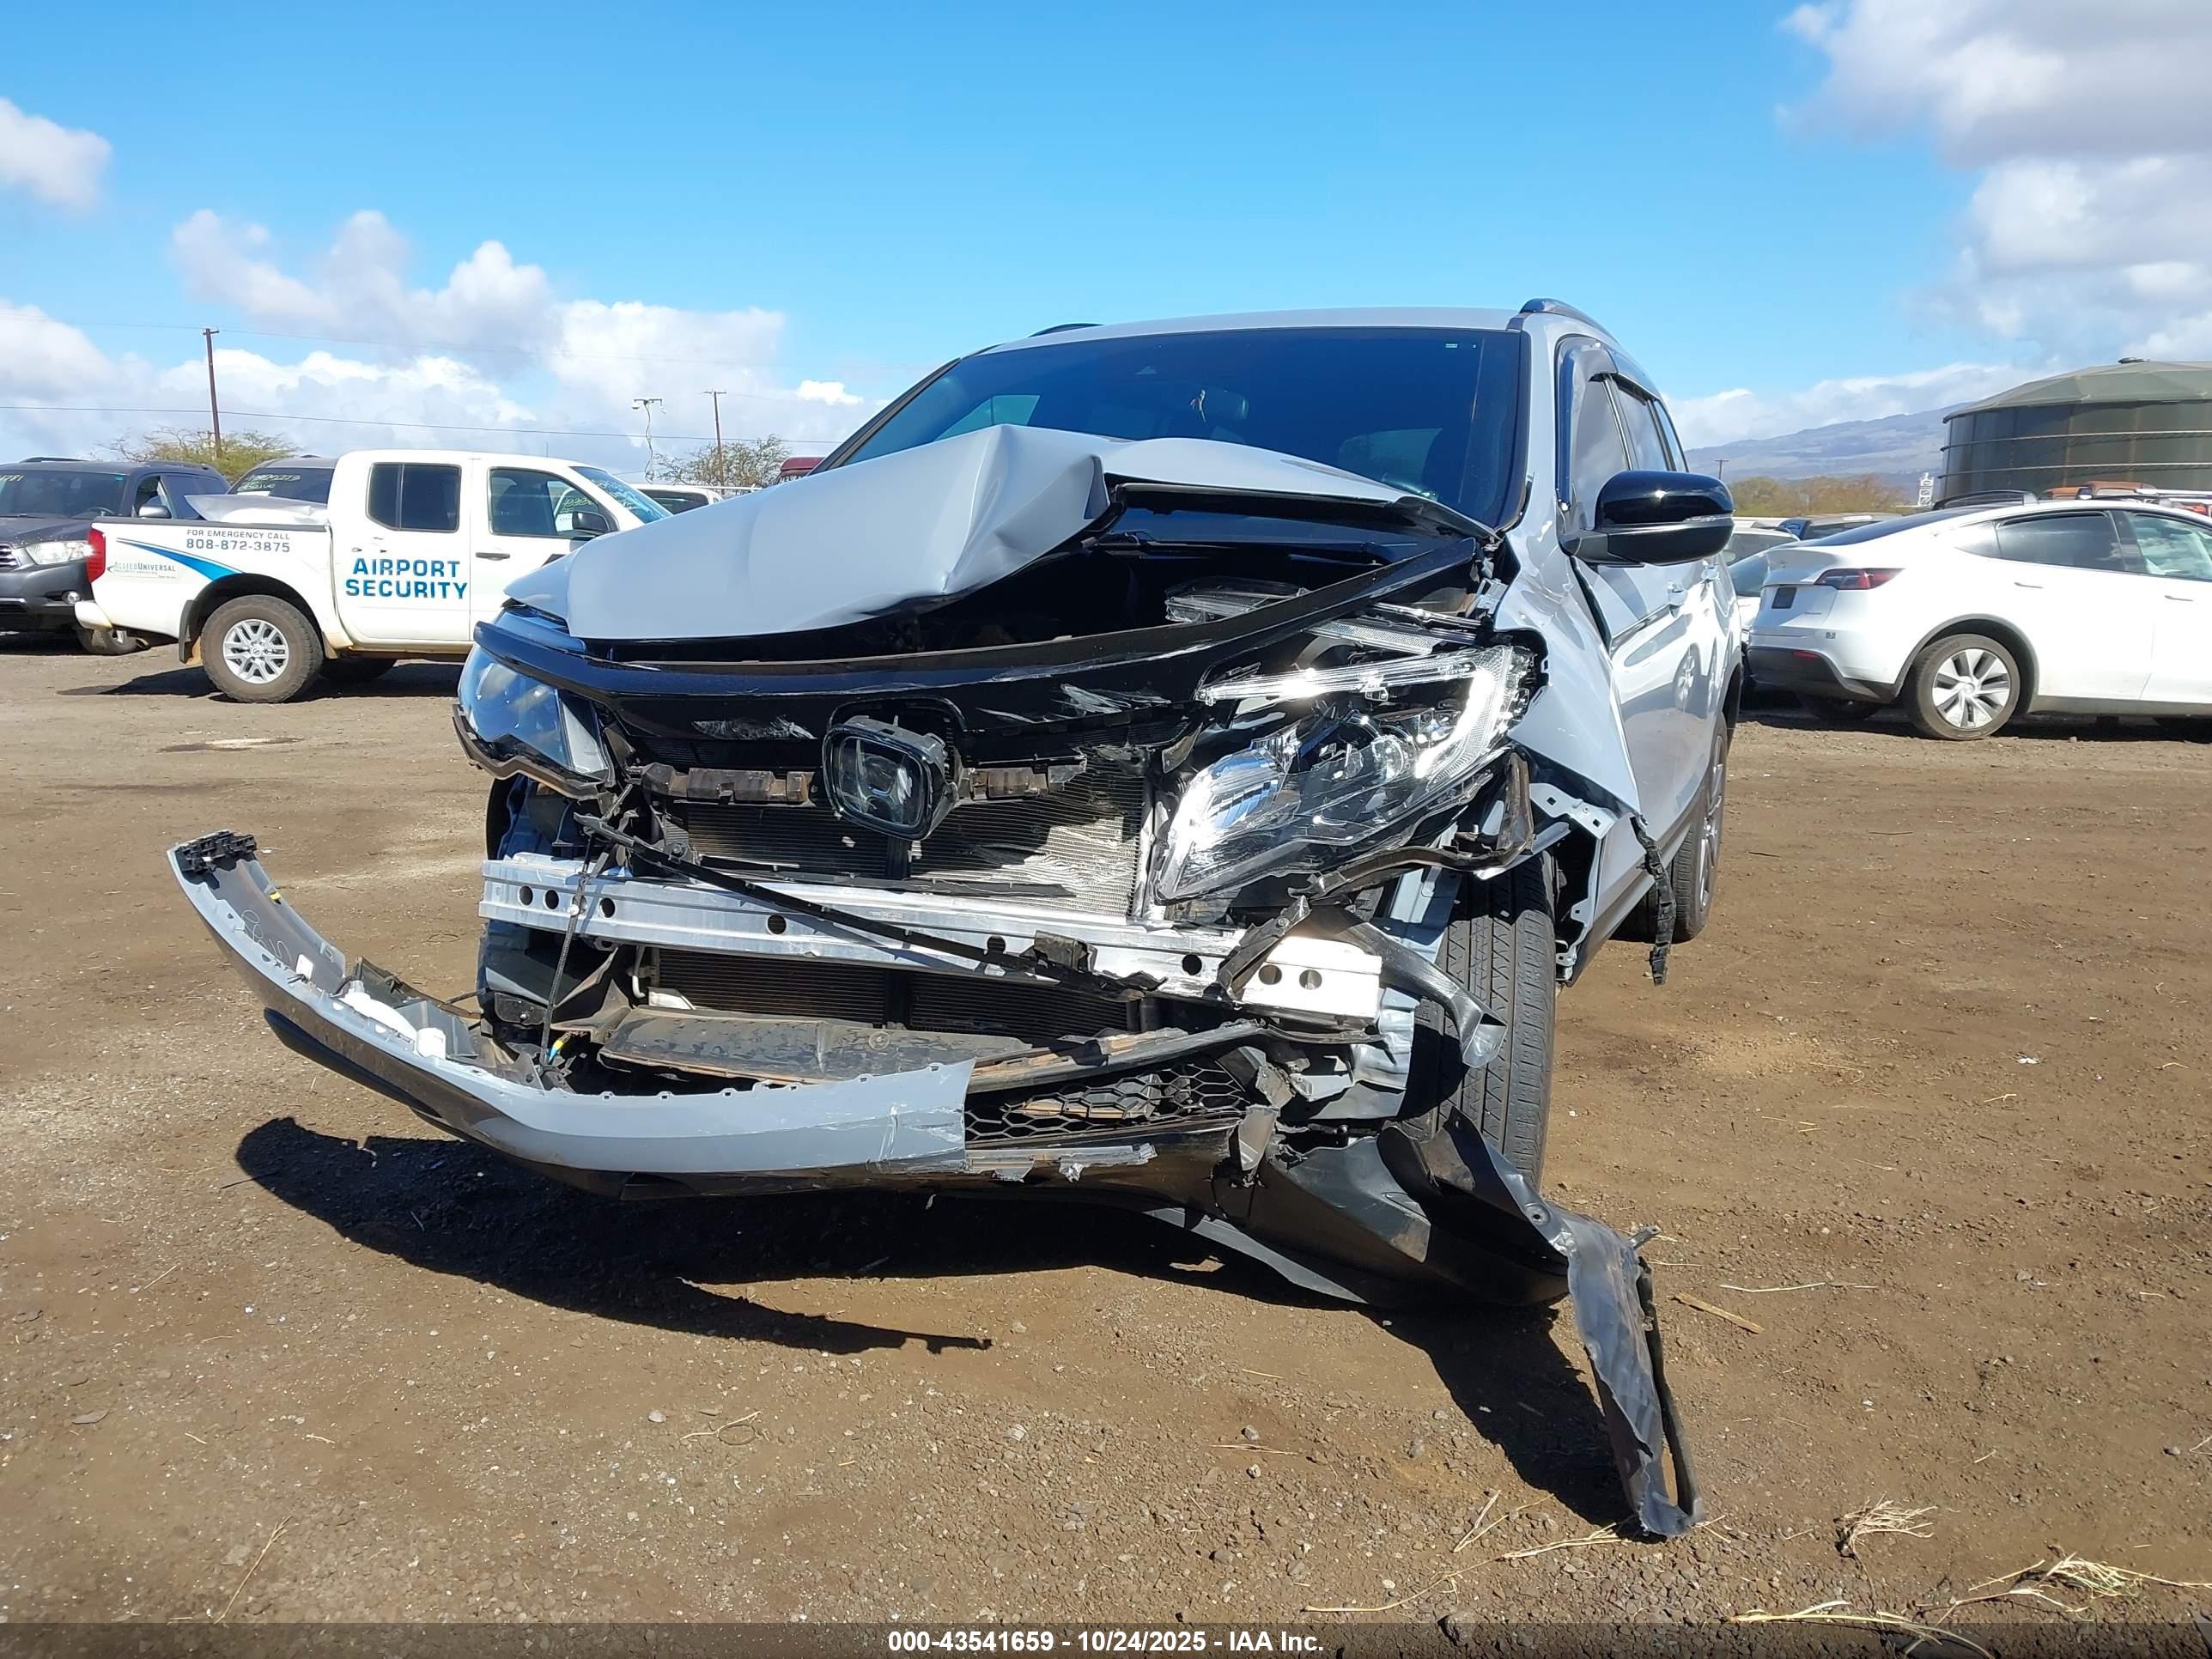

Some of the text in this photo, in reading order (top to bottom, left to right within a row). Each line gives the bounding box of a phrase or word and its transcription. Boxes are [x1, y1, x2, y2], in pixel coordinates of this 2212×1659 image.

[207, 530, 264, 538] EMERGENCY
[186, 538, 290, 552] 808-872-3875
[352, 558, 460, 578] AIRPORT
[345, 579, 468, 599] SECURITY
